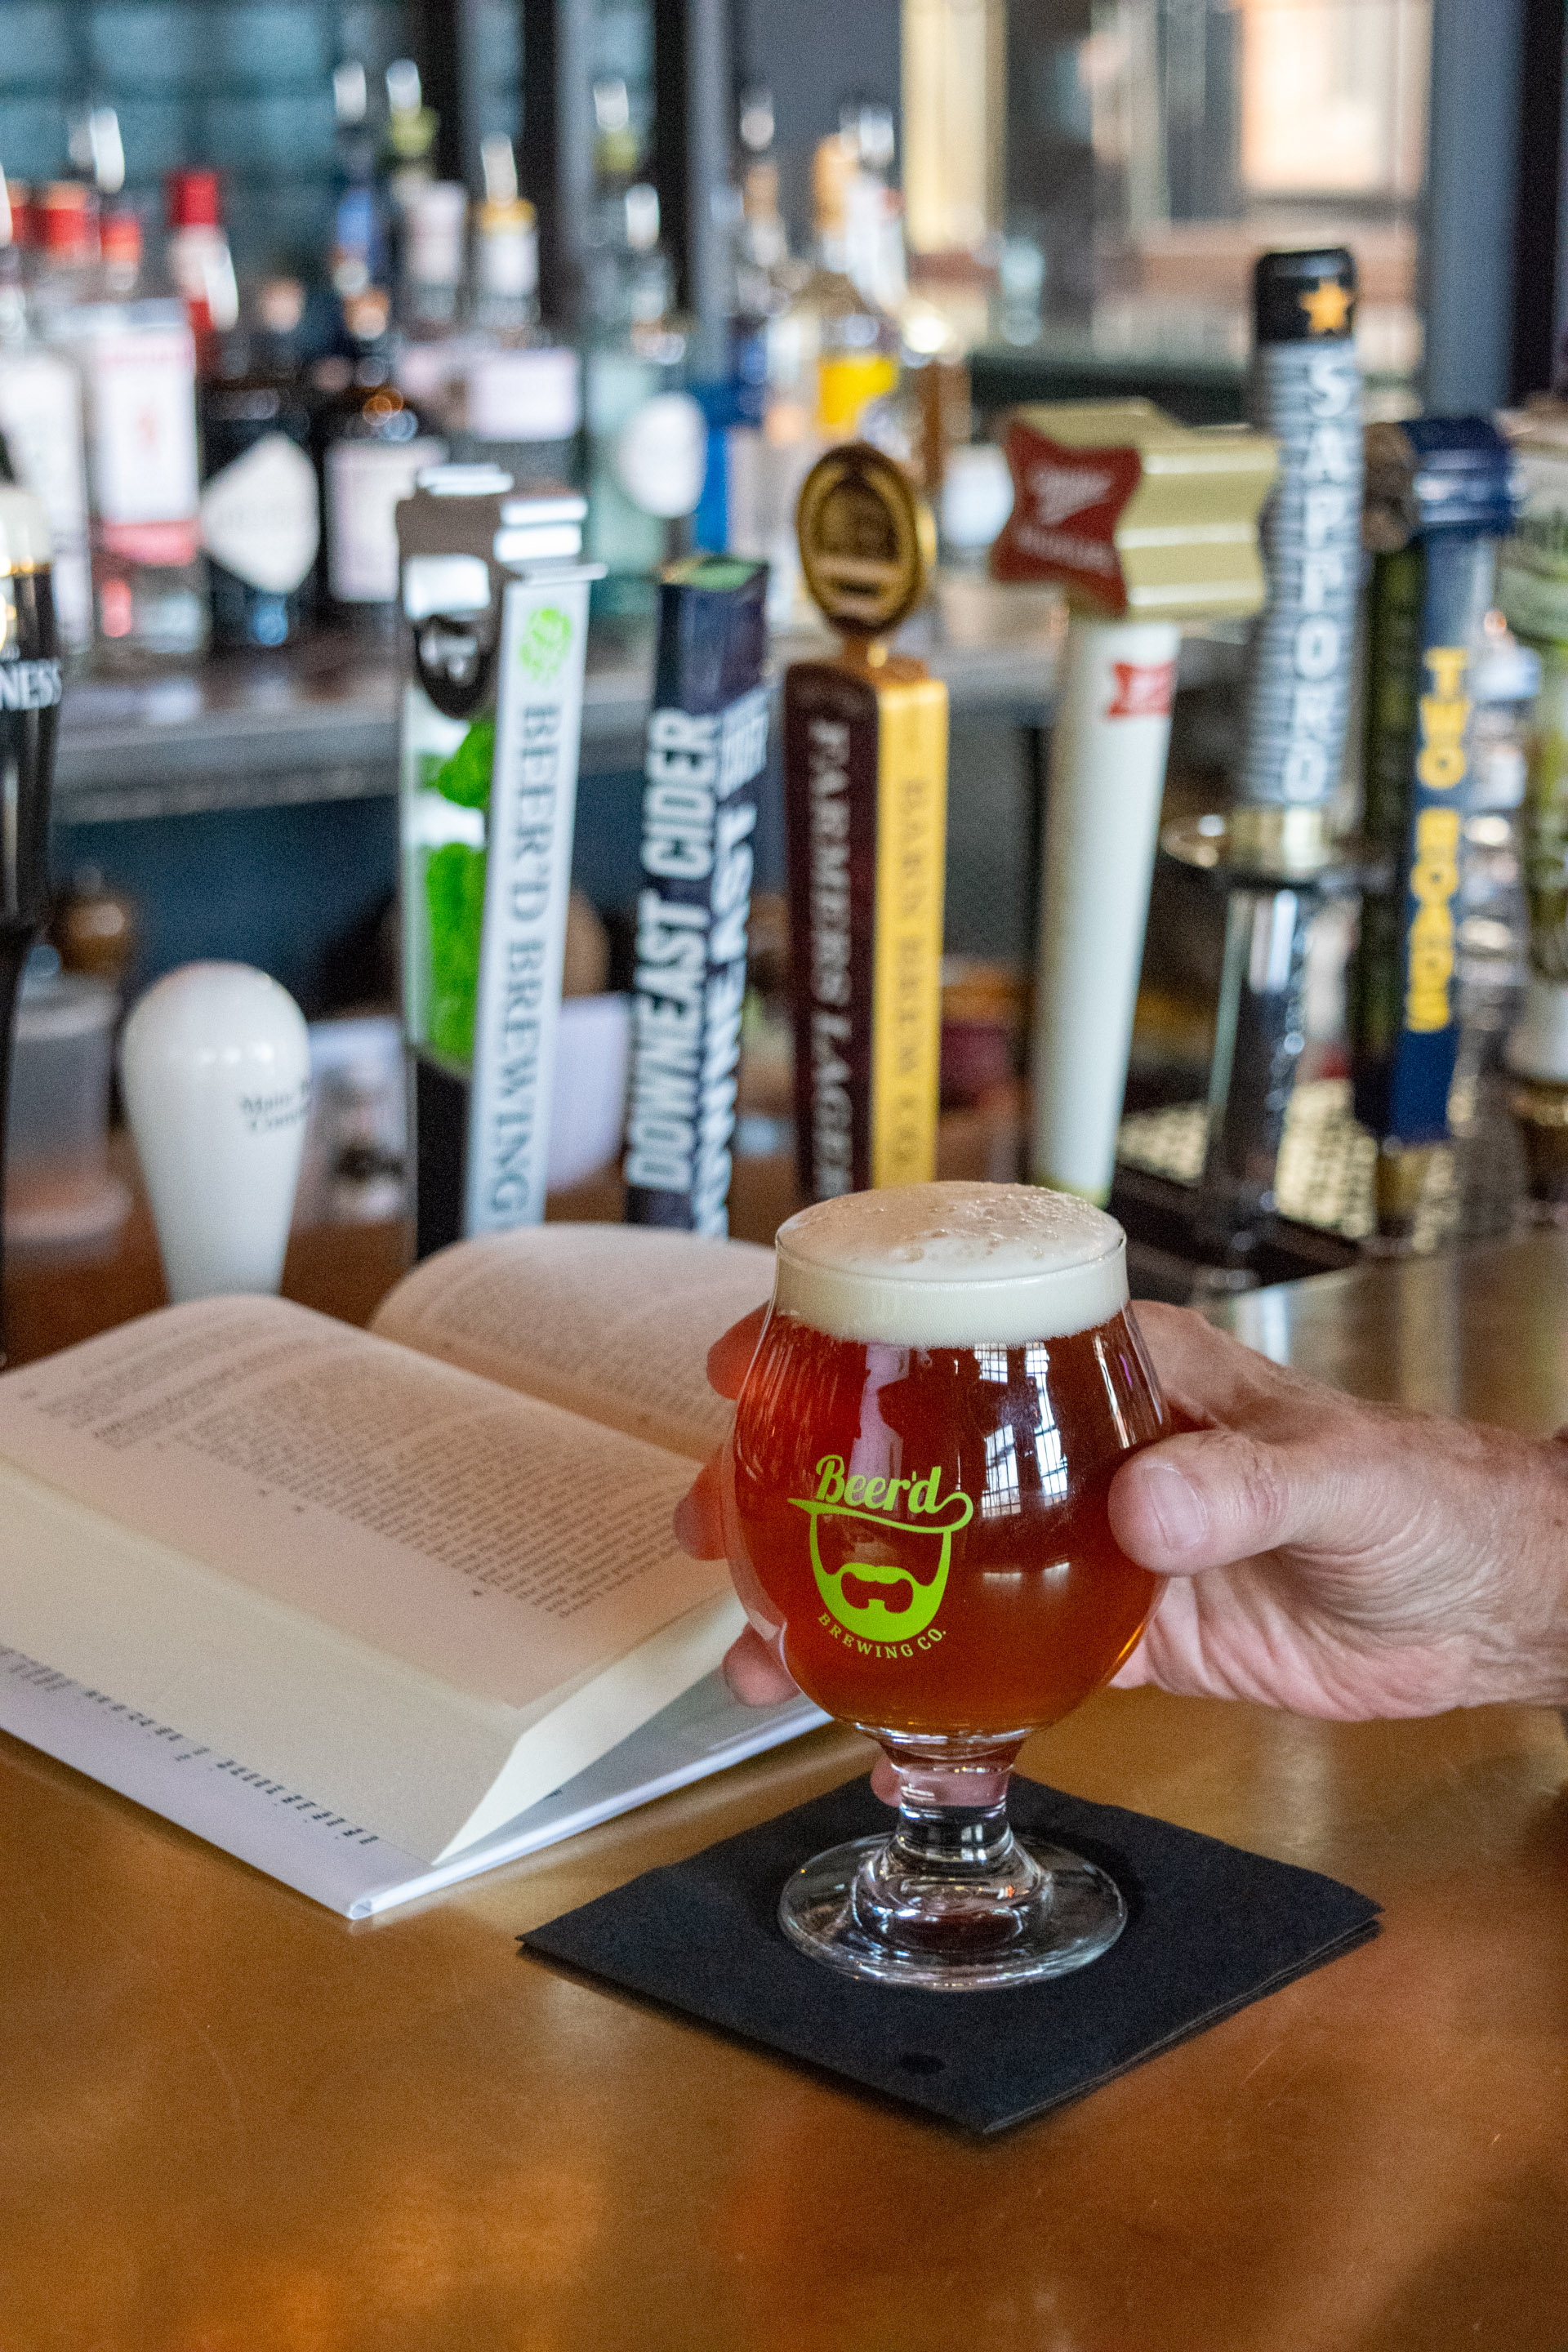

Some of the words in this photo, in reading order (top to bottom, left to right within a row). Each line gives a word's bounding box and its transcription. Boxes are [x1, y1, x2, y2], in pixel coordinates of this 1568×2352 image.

[511, 704, 559, 923] BEER'D
[642, 707, 721, 880] CIDER
[1414, 645, 1472, 790] TWO
[809, 720, 852, 1005] FARMERS
[489, 940, 546, 1215] BREWING
[626, 889, 712, 1192] DOWNEAST
[816, 1454, 943, 1514] Beer'd
[817, 1612, 914, 1659] BREWING
[916, 1628, 947, 1650] CO.
